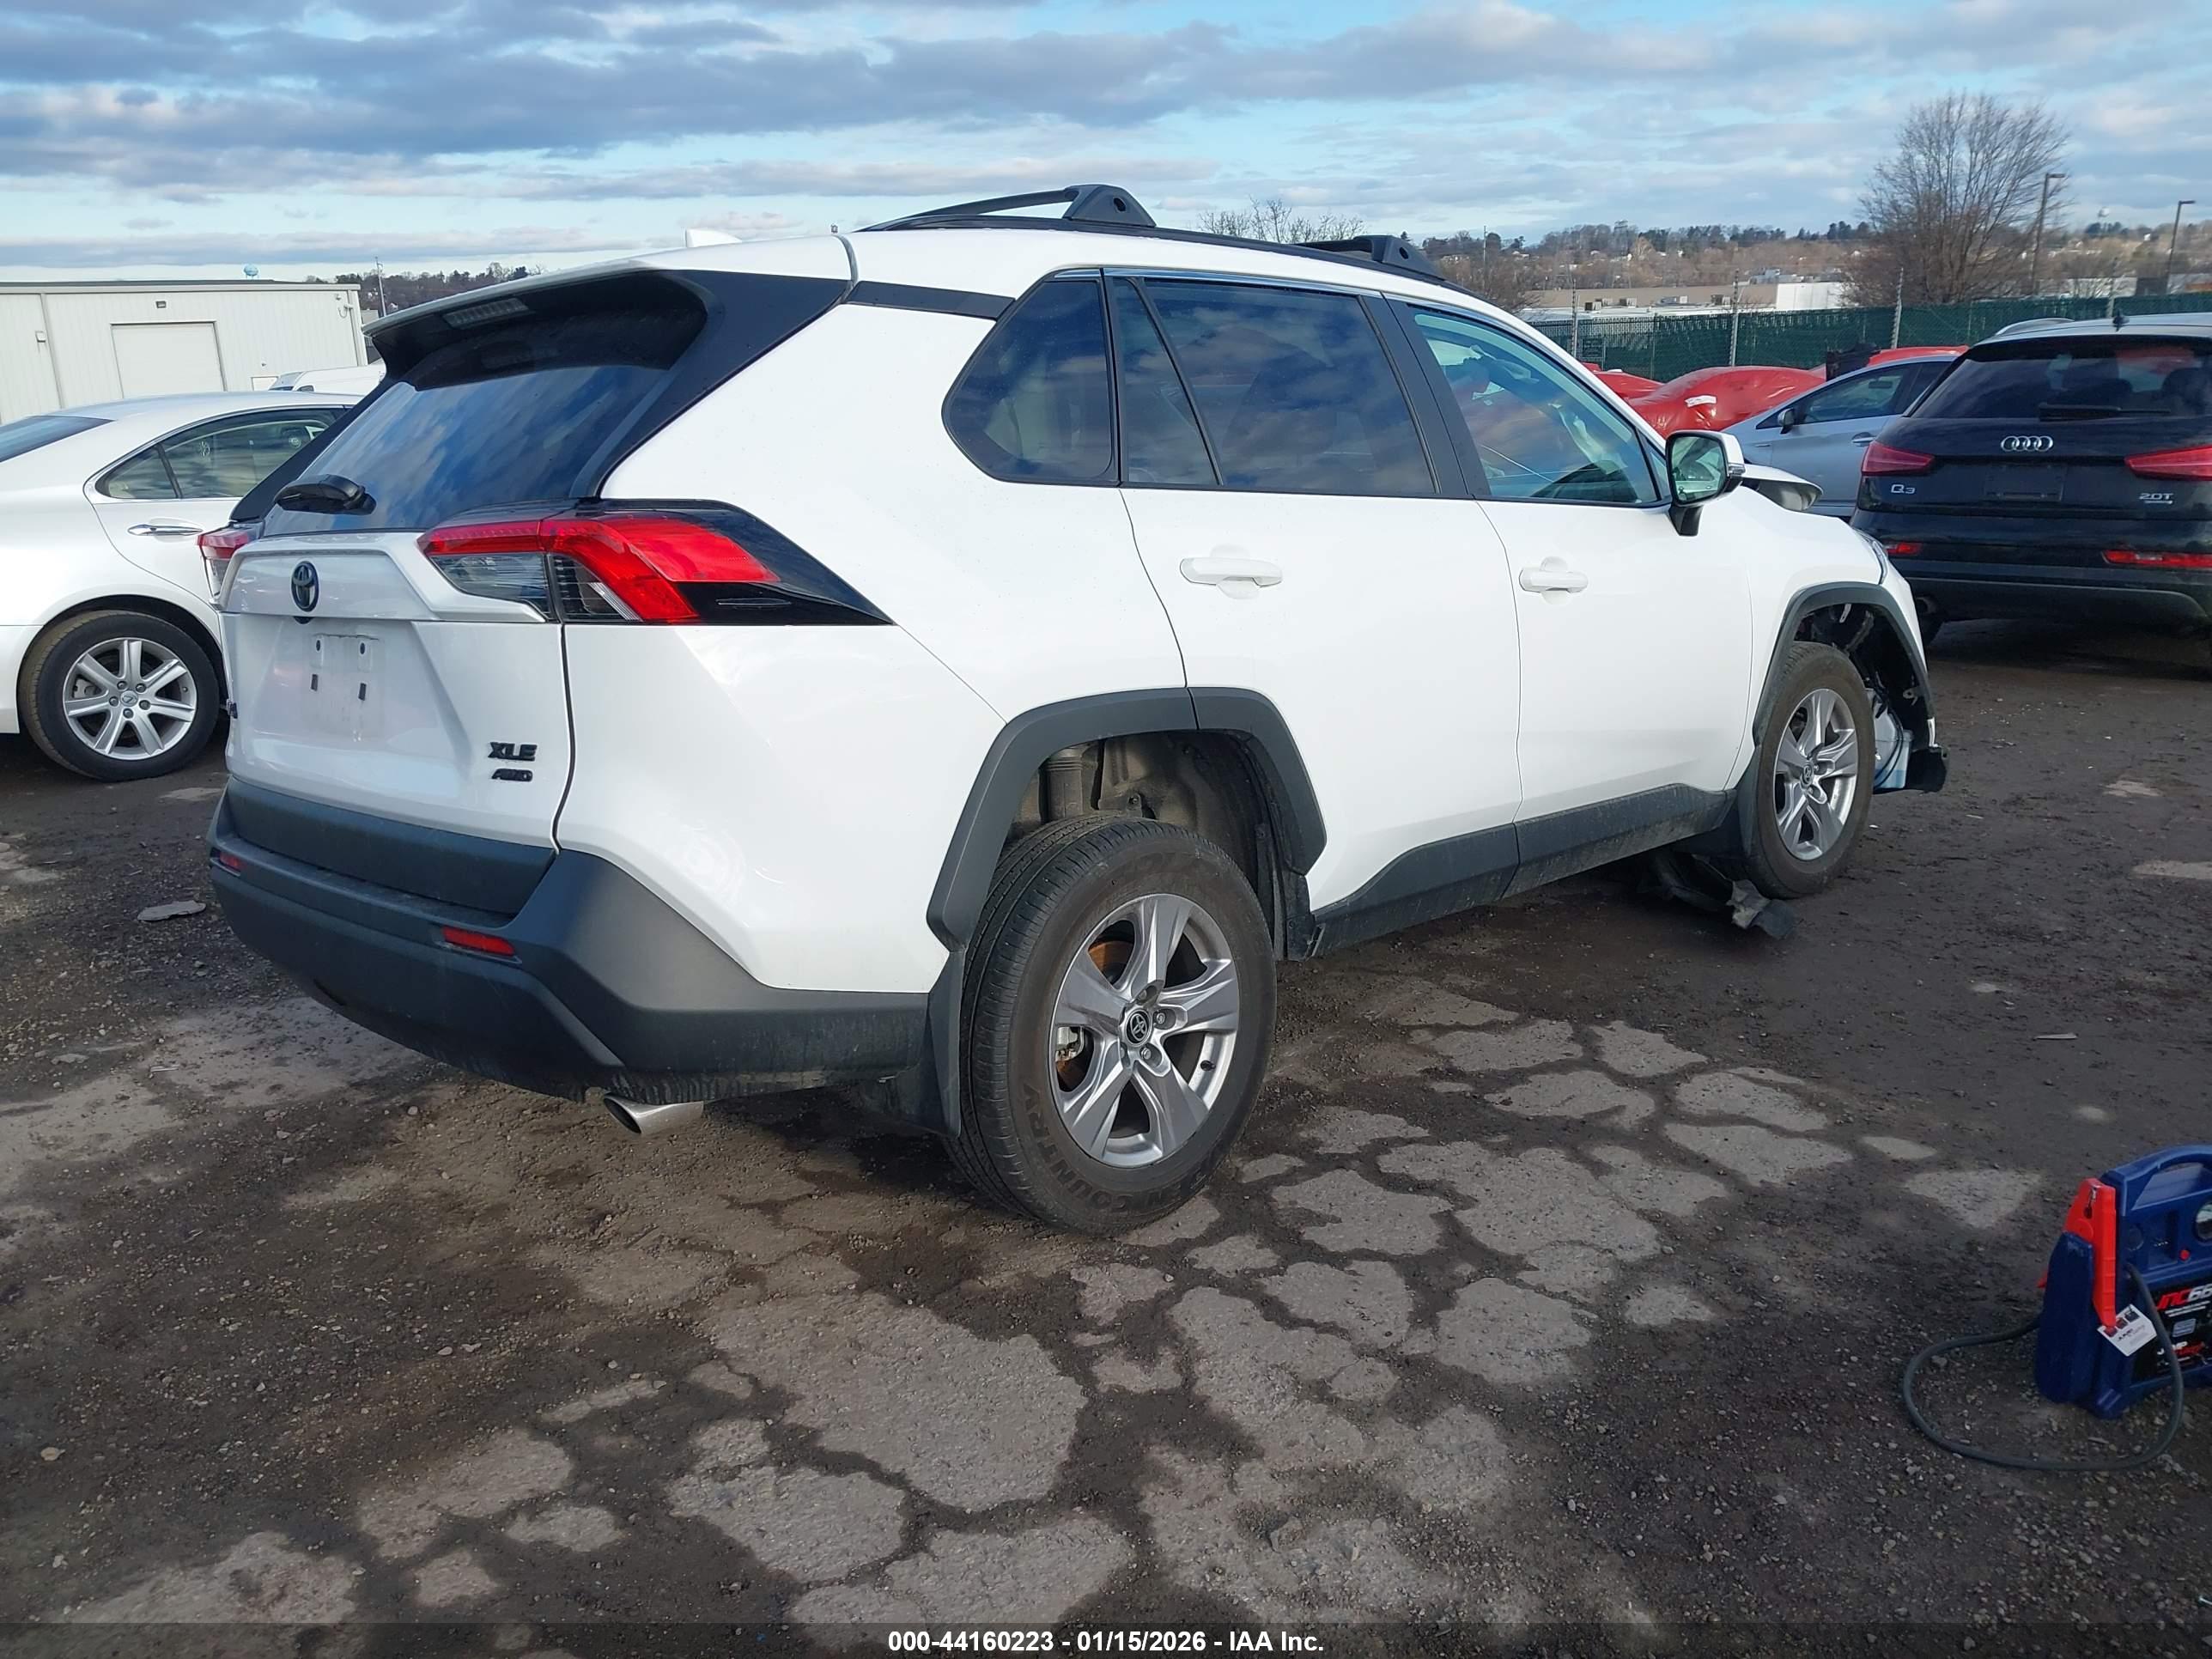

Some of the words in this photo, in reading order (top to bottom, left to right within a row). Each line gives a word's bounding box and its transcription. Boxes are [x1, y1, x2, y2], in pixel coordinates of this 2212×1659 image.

[1891, 483, 1916, 495] Q3
[488, 742, 538, 762] XLE
[491, 769, 533, 782] AWD
